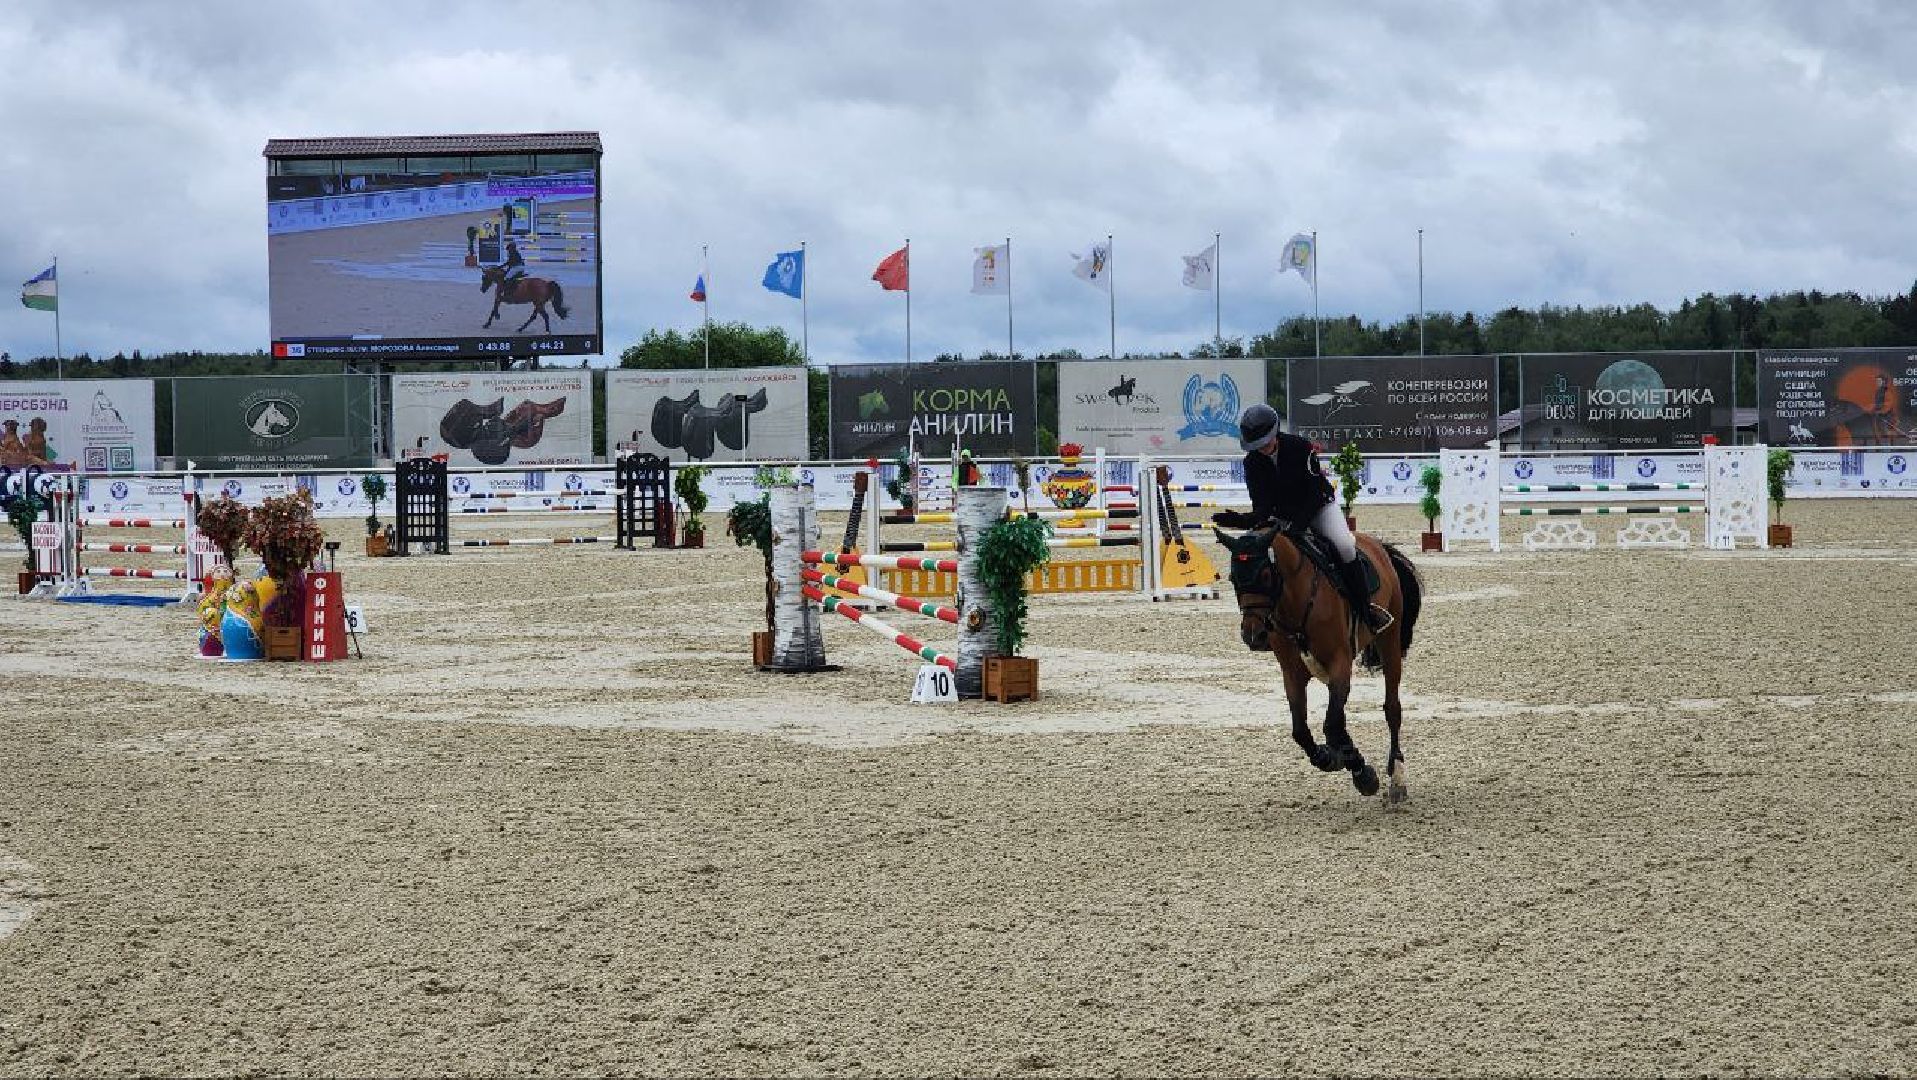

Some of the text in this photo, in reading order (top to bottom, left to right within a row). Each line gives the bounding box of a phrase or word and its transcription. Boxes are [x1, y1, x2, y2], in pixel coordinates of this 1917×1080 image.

[1387, 379, 1488, 391] КОНЕПЕРЕВОЗКИ
[913, 389, 1012, 411] КОРМА
[1388, 391, 1488, 404] ПО ВСЕЙ РОССИИ
[1587, 388, 1715, 405] КОСМЕТИКА
[0, 399, 68, 410] ЕРСБЭНД
[1546, 405, 1576, 420] DEUS
[1588, 405, 1691, 421] ДЛЯ ЛОШАДЕЙ
[1776, 409, 1825, 418] ПОДПРУГИ
[912, 414, 1013, 435] АНИЛИН
[1388, 427, 1400, 436] +7
[1404, 426, 1431, 438] (981)
[1298, 428, 1383, 439] KONETAXI
[311, 578, 327, 659] ФИНИШ
[349, 611, 358, 628] 6
[931, 671, 949, 697] 10
